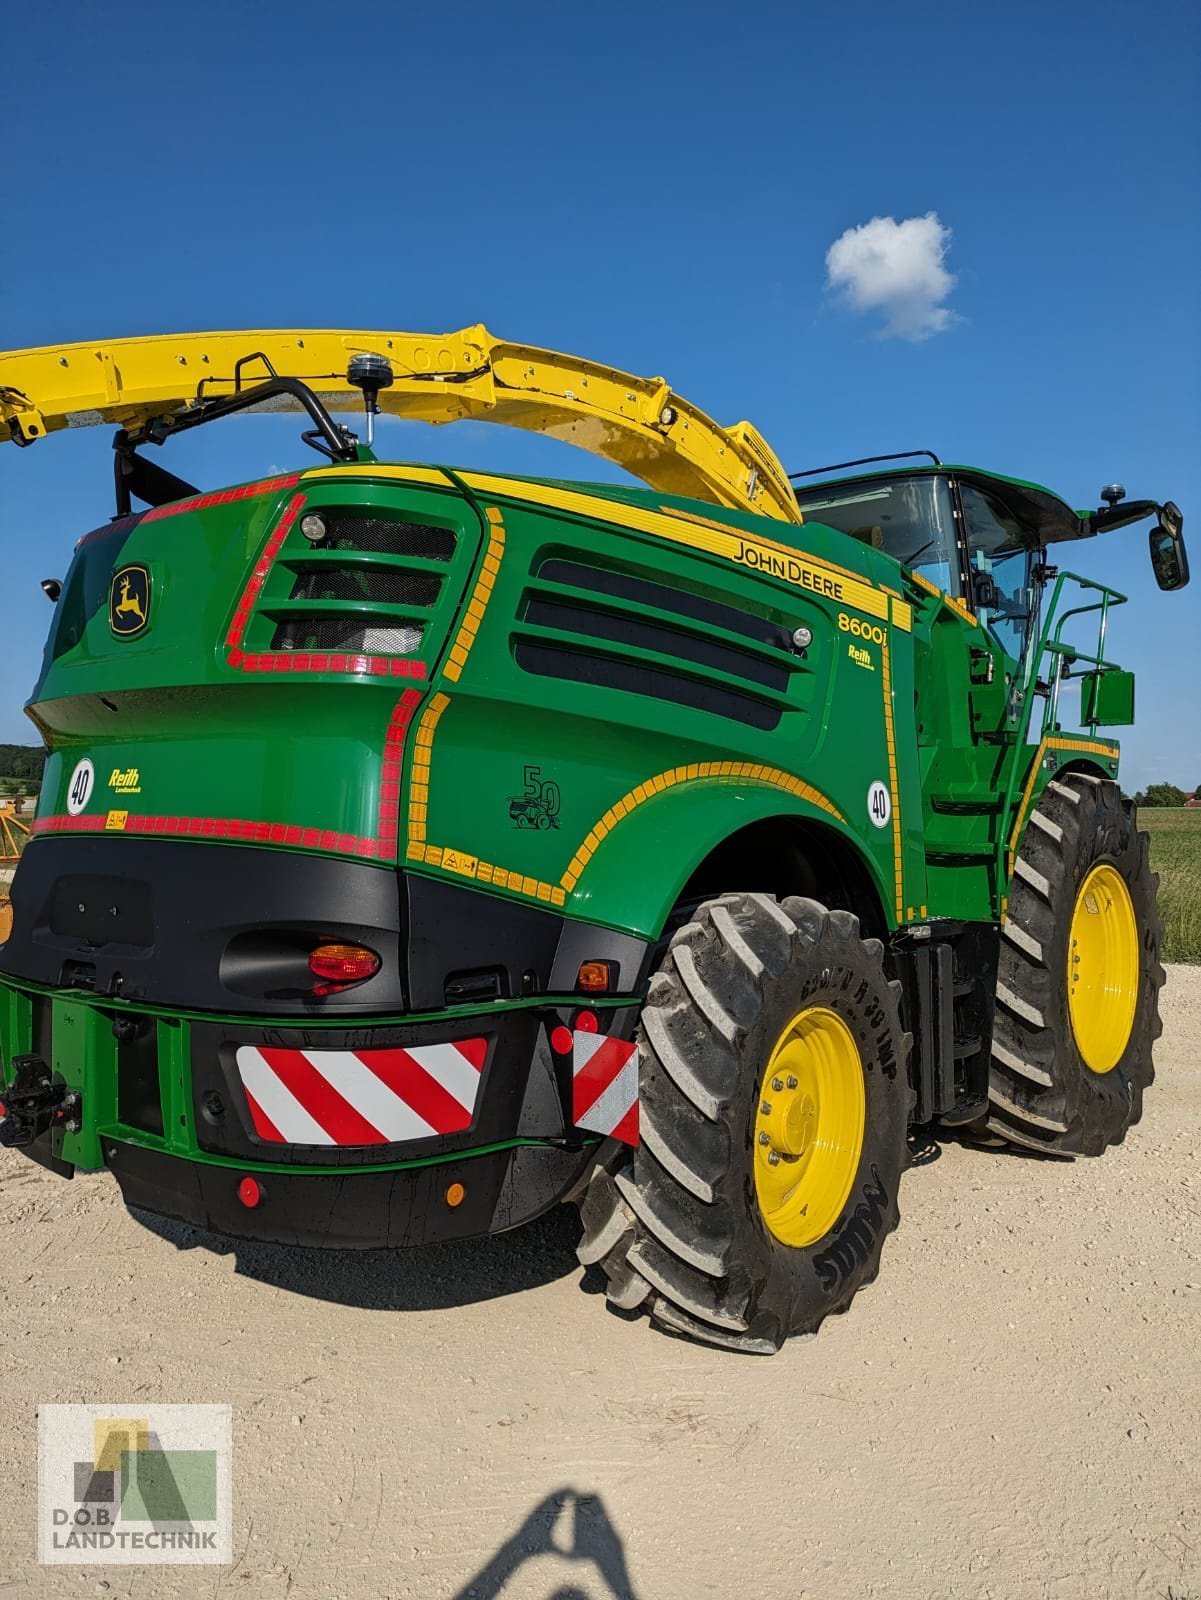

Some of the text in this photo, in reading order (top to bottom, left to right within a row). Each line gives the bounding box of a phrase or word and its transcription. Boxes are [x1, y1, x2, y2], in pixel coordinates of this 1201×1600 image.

[733, 541, 843, 600] JOHN DEERE
[837, 612, 888, 647] 8600i
[71, 769, 90, 805] 40
[108, 769, 139, 786] Reith
[523, 765, 561, 817] 50
[872, 789, 886, 819] 40
